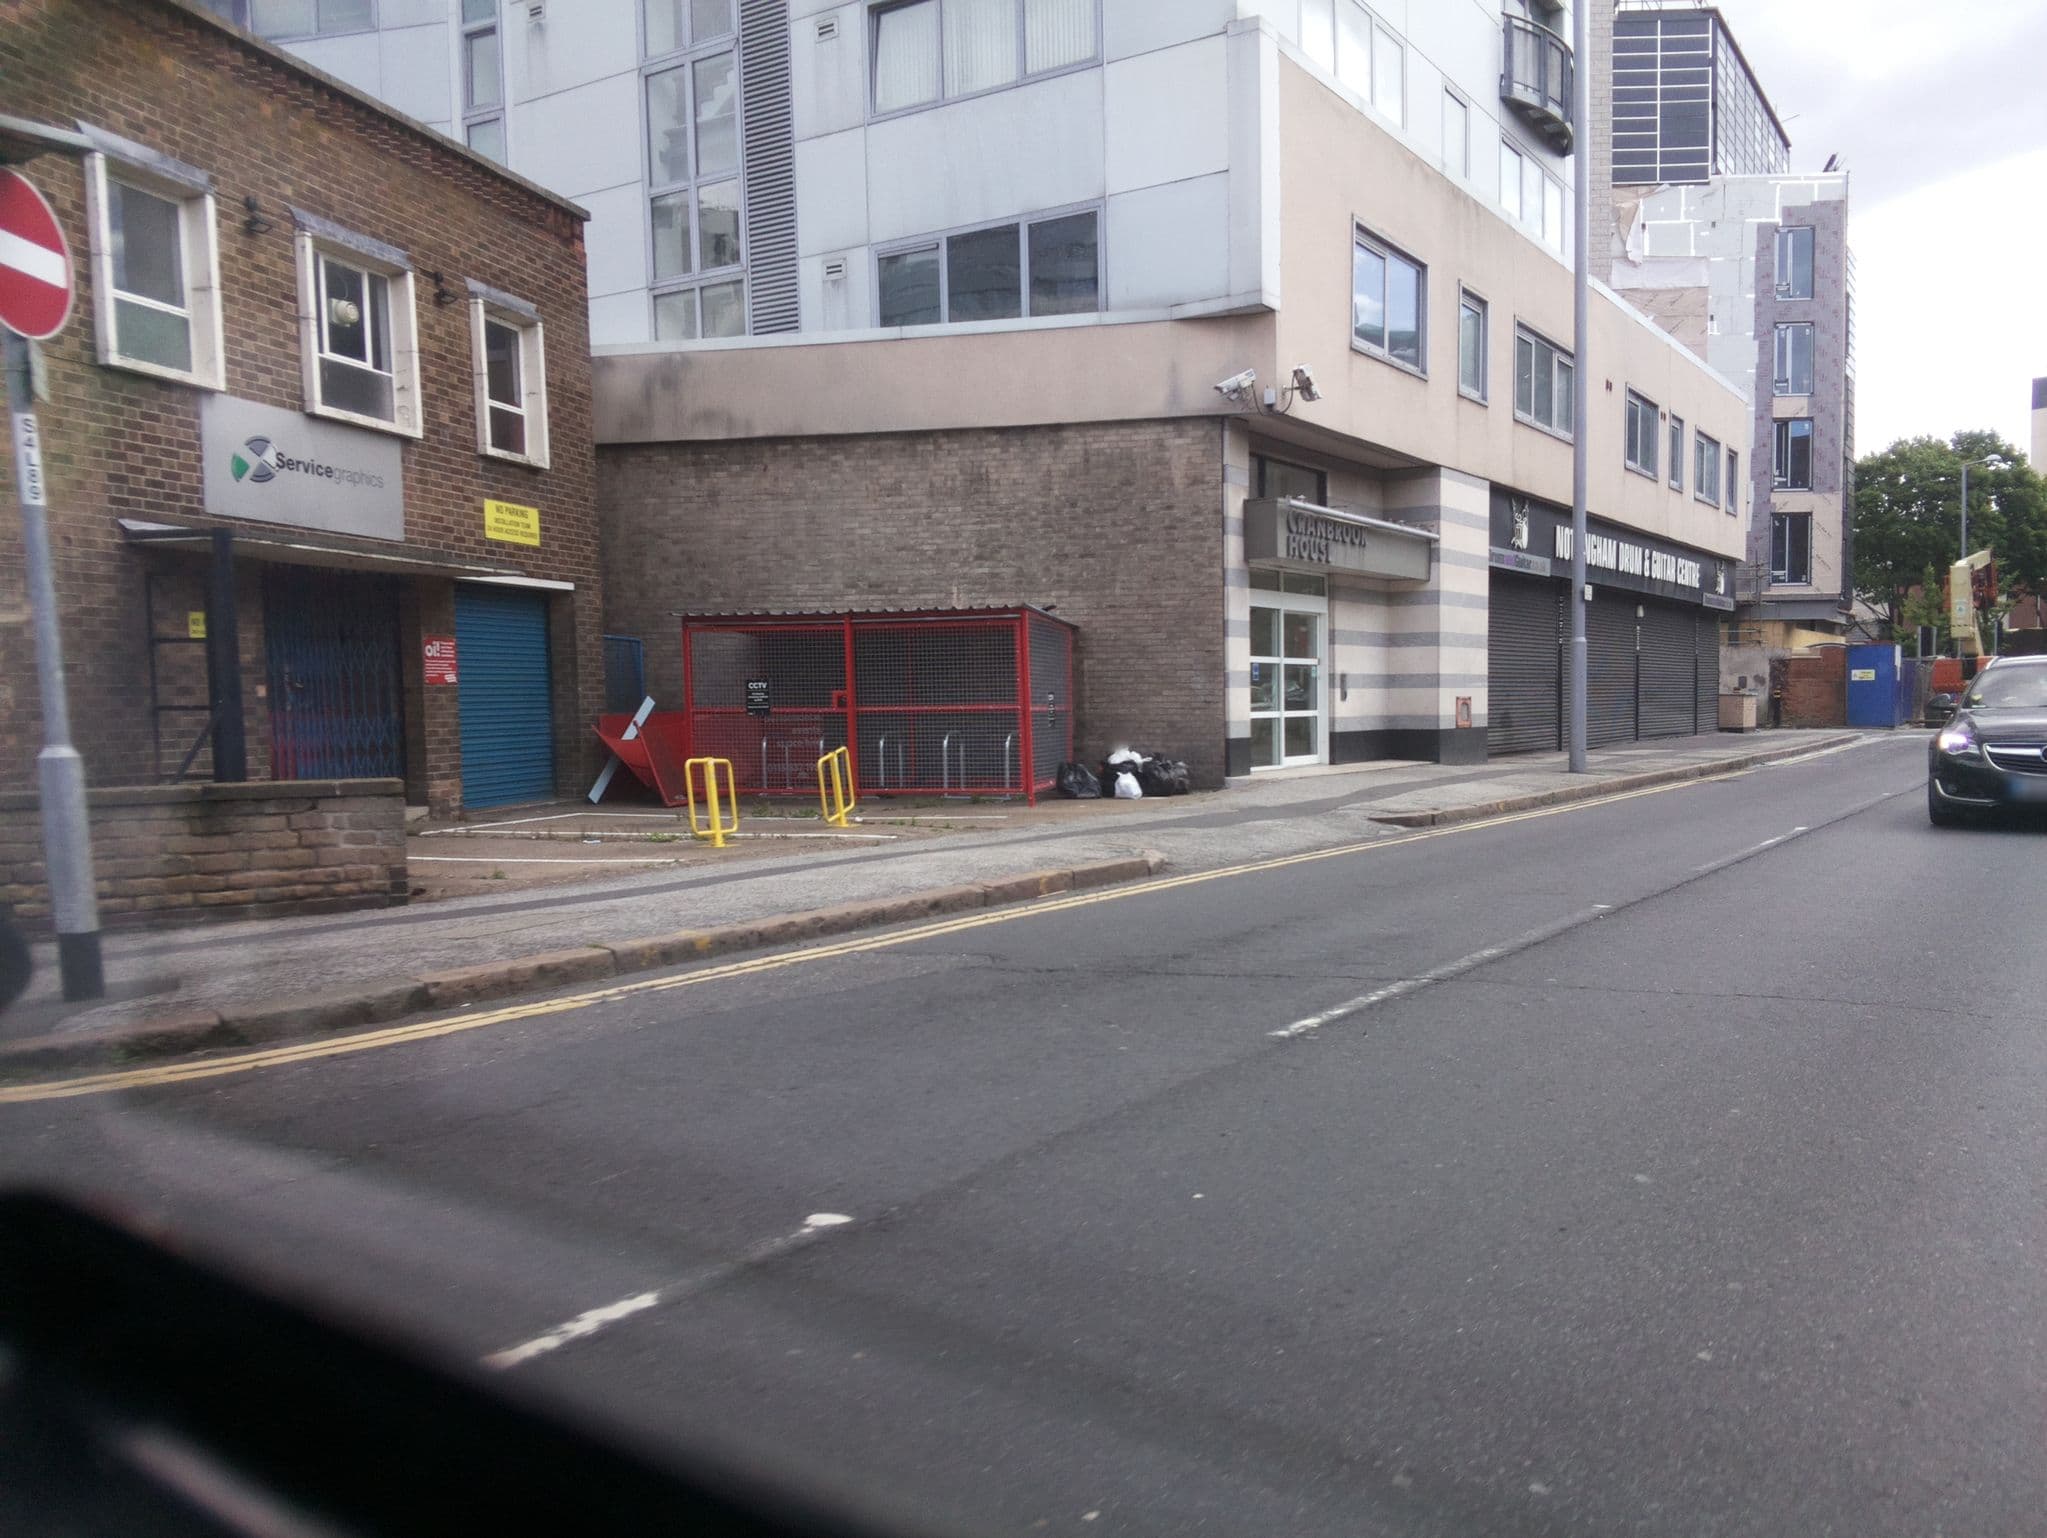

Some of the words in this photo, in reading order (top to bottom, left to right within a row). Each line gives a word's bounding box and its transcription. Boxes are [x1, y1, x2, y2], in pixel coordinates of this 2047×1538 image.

[505, 506, 528, 519] PARKING
[1619, 541, 1643, 577] DRUM
[1644, 549, 1650, 578] &
[1651, 550, 1676, 583] GUITAR
[1677, 557, 1700, 589] CENTRE
